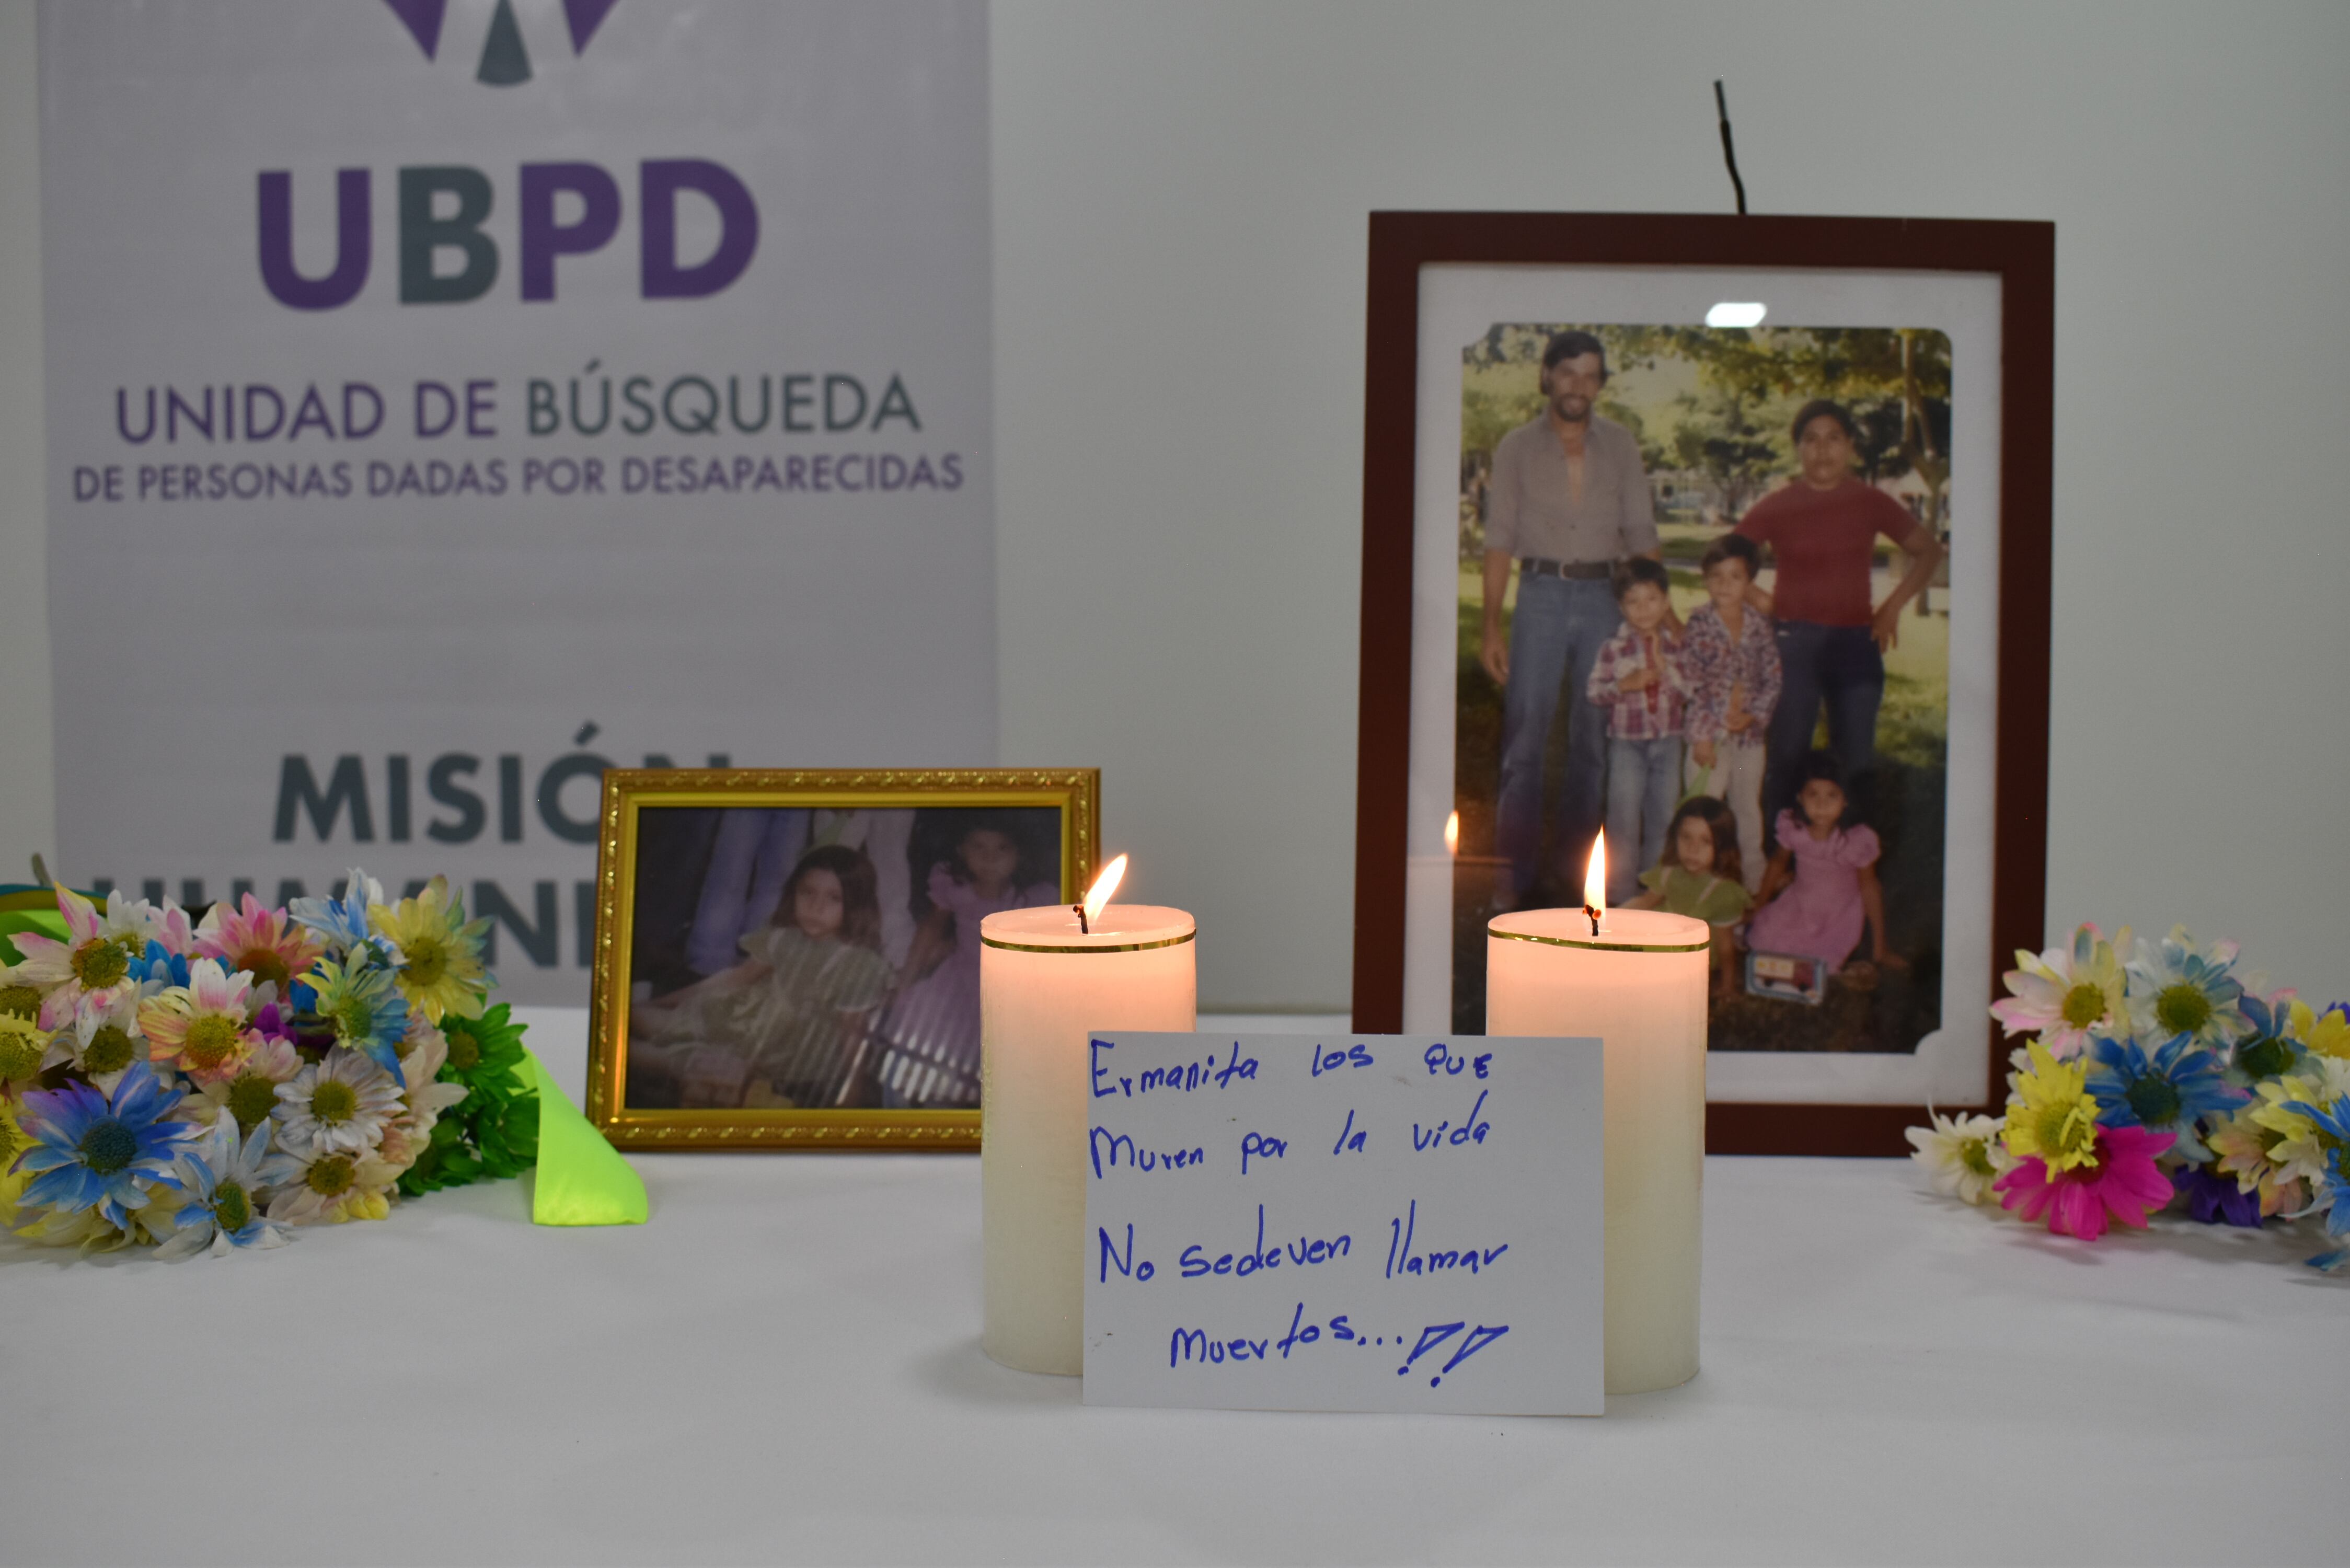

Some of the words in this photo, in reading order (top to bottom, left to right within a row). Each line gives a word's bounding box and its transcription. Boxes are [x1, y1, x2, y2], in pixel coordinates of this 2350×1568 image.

[257, 158, 759, 312] UBPD
[116, 382, 385, 445] UNIDAD
[414, 379, 497, 439] DE
[527, 360, 921, 437] BÚSQUEDA
[73, 465, 122, 502] DE
[138, 462, 352, 501] PERSONAS
[367, 459, 506, 497] DADAS
[524, 458, 603, 494] POR
[623, 454, 963, 493] DESAPARECIDAS
[271, 721, 730, 846] MISIÓ
[1092, 1040, 1259, 1098] Ermanita
[1242, 1133, 1287, 1174] por
[1334, 1110, 1367, 1155] la
[1414, 1090, 1490, 1151] vida
[1099, 1224, 1155, 1283] No
[1386, 1200, 1508, 1279] llamar
